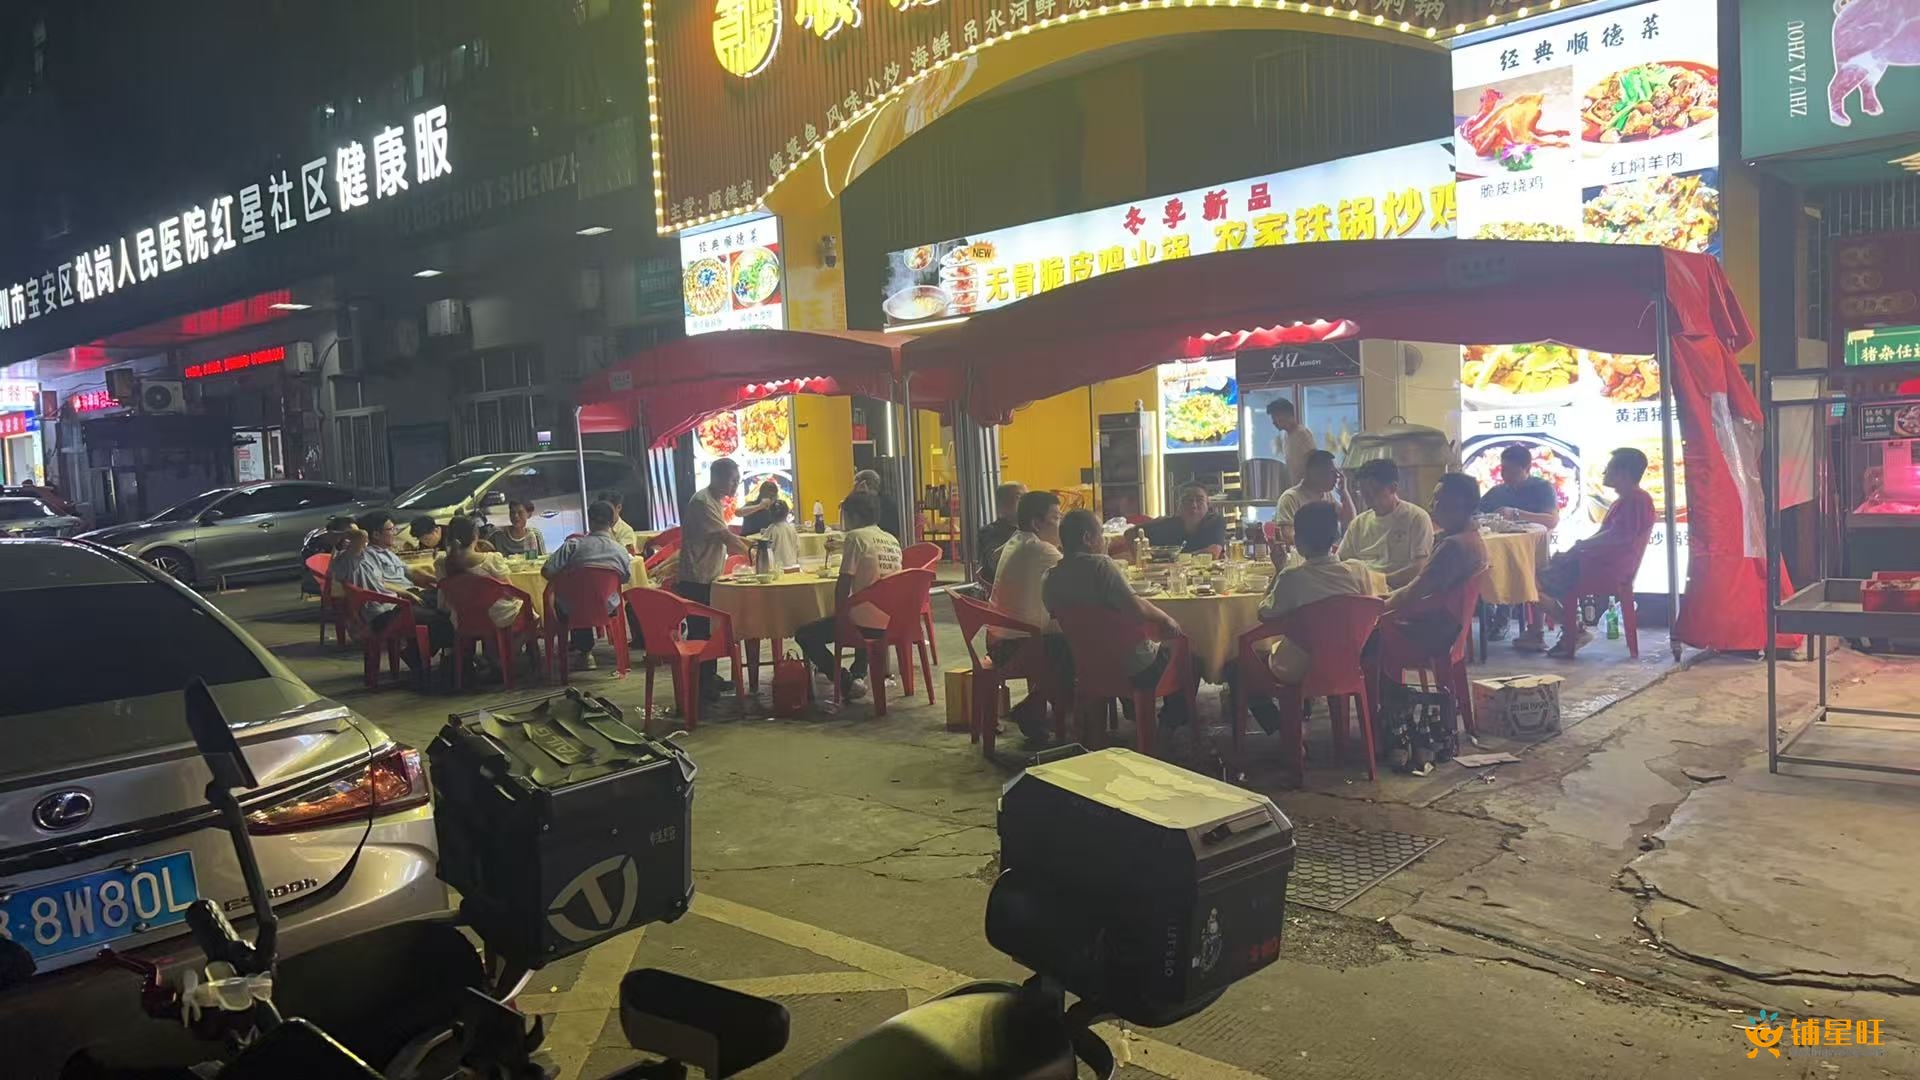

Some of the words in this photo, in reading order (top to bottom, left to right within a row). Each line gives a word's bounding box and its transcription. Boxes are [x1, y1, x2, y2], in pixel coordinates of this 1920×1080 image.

[911, 31, 952, 71] 海鲜
[1500, 13, 1660, 71] 经典顺德菜
[1787, 20, 1805, 62] ZHOU
[1789, 63, 1806, 84] ZA
[825, 60, 901, 130] 风味小炒
[1790, 86, 1807, 117] ZHU
[1610, 150, 1684, 176] 红焖羊肉
[1479, 175, 1544, 199] 脆皮烧鸡
[1123, 183, 1272, 234] 冬季新品
[972, 247, 992, 258] NEW
[1478, 413, 1557, 429] 一品桶皇鸡
